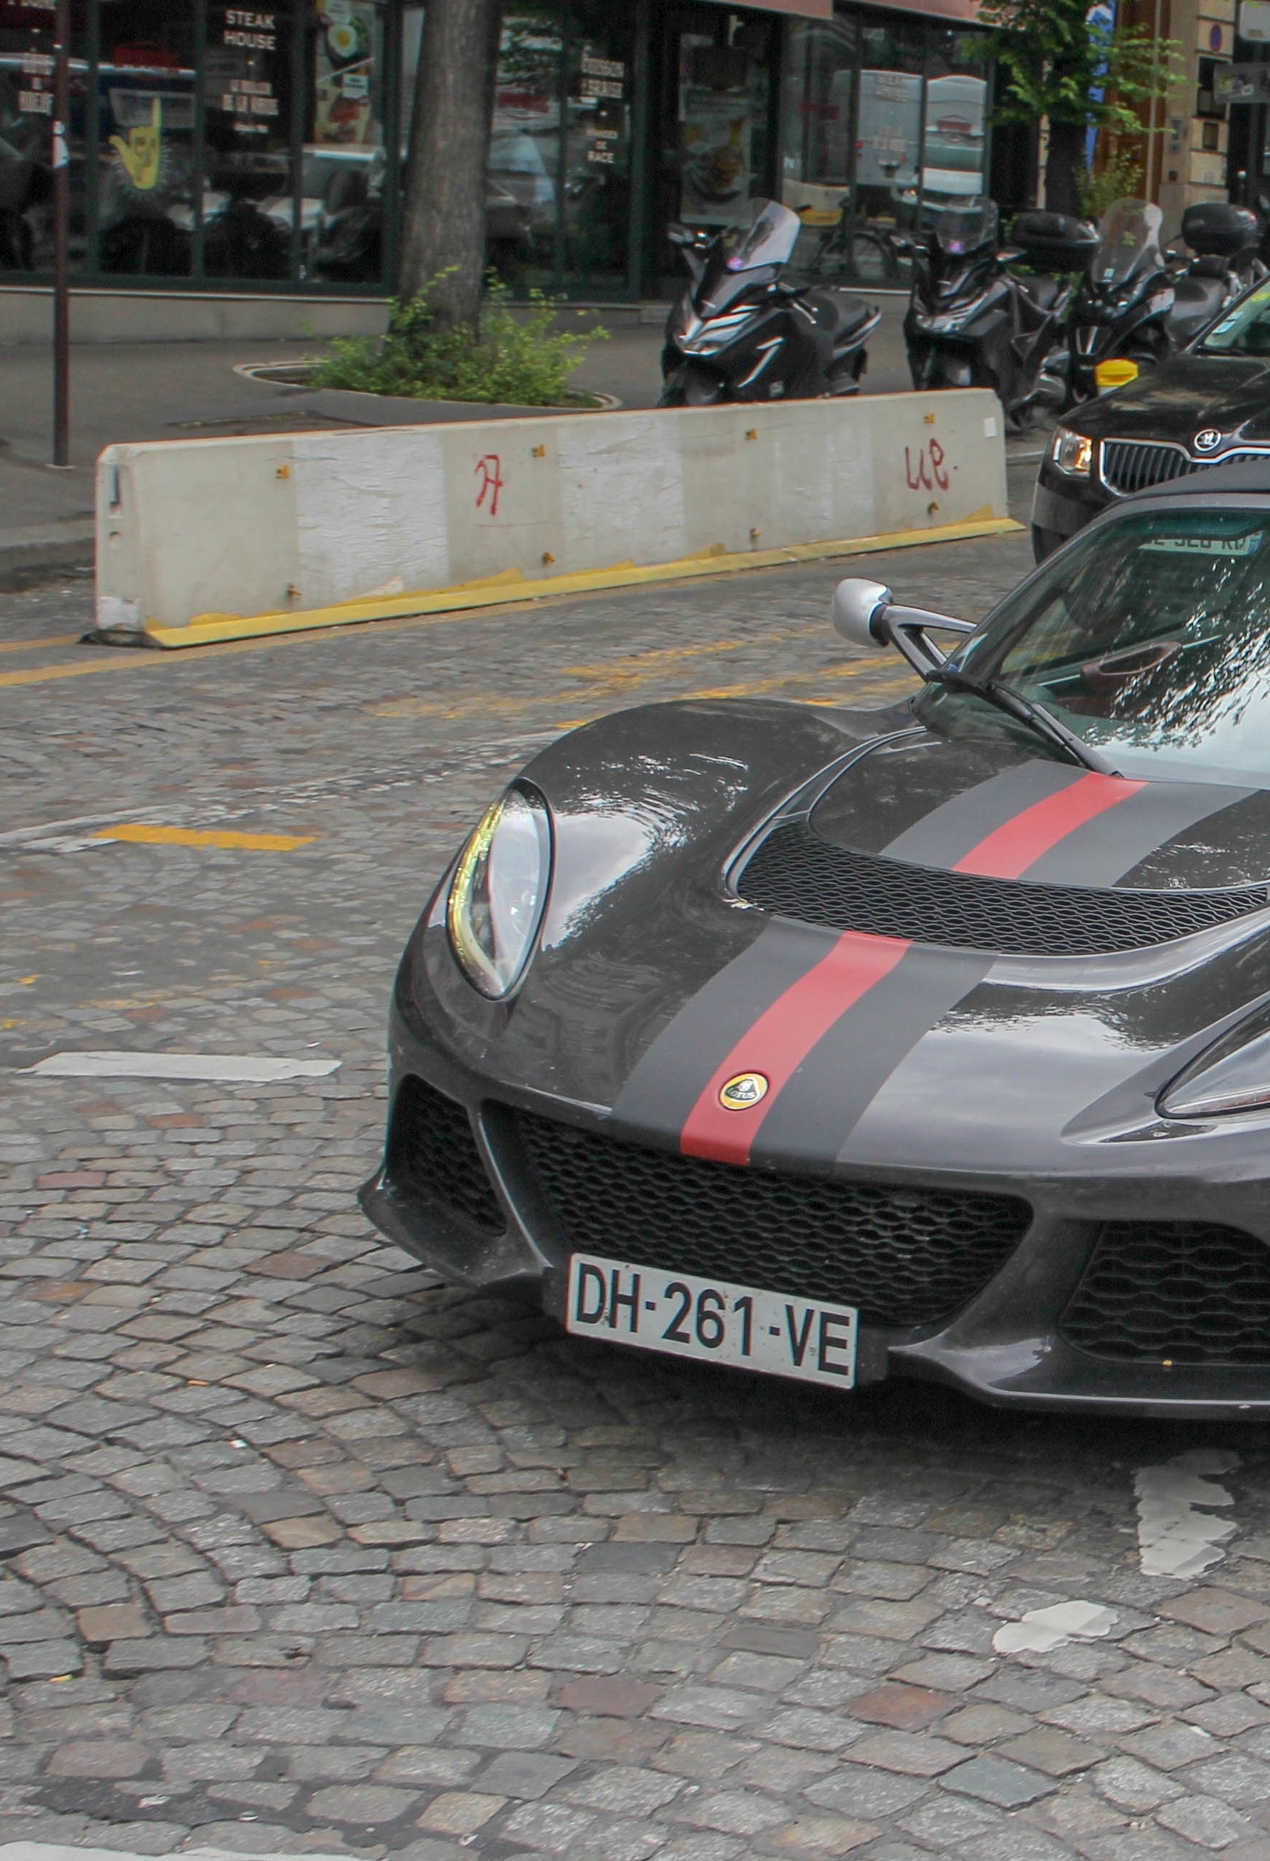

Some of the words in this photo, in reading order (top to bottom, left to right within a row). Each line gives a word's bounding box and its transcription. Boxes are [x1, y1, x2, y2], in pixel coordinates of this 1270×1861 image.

[225, 9, 276, 29] STEAK
[223, 29, 277, 50] HOUSE
[586, 149, 615, 164] RACE
[576, 1262, 851, 1377] DH-261-VE
